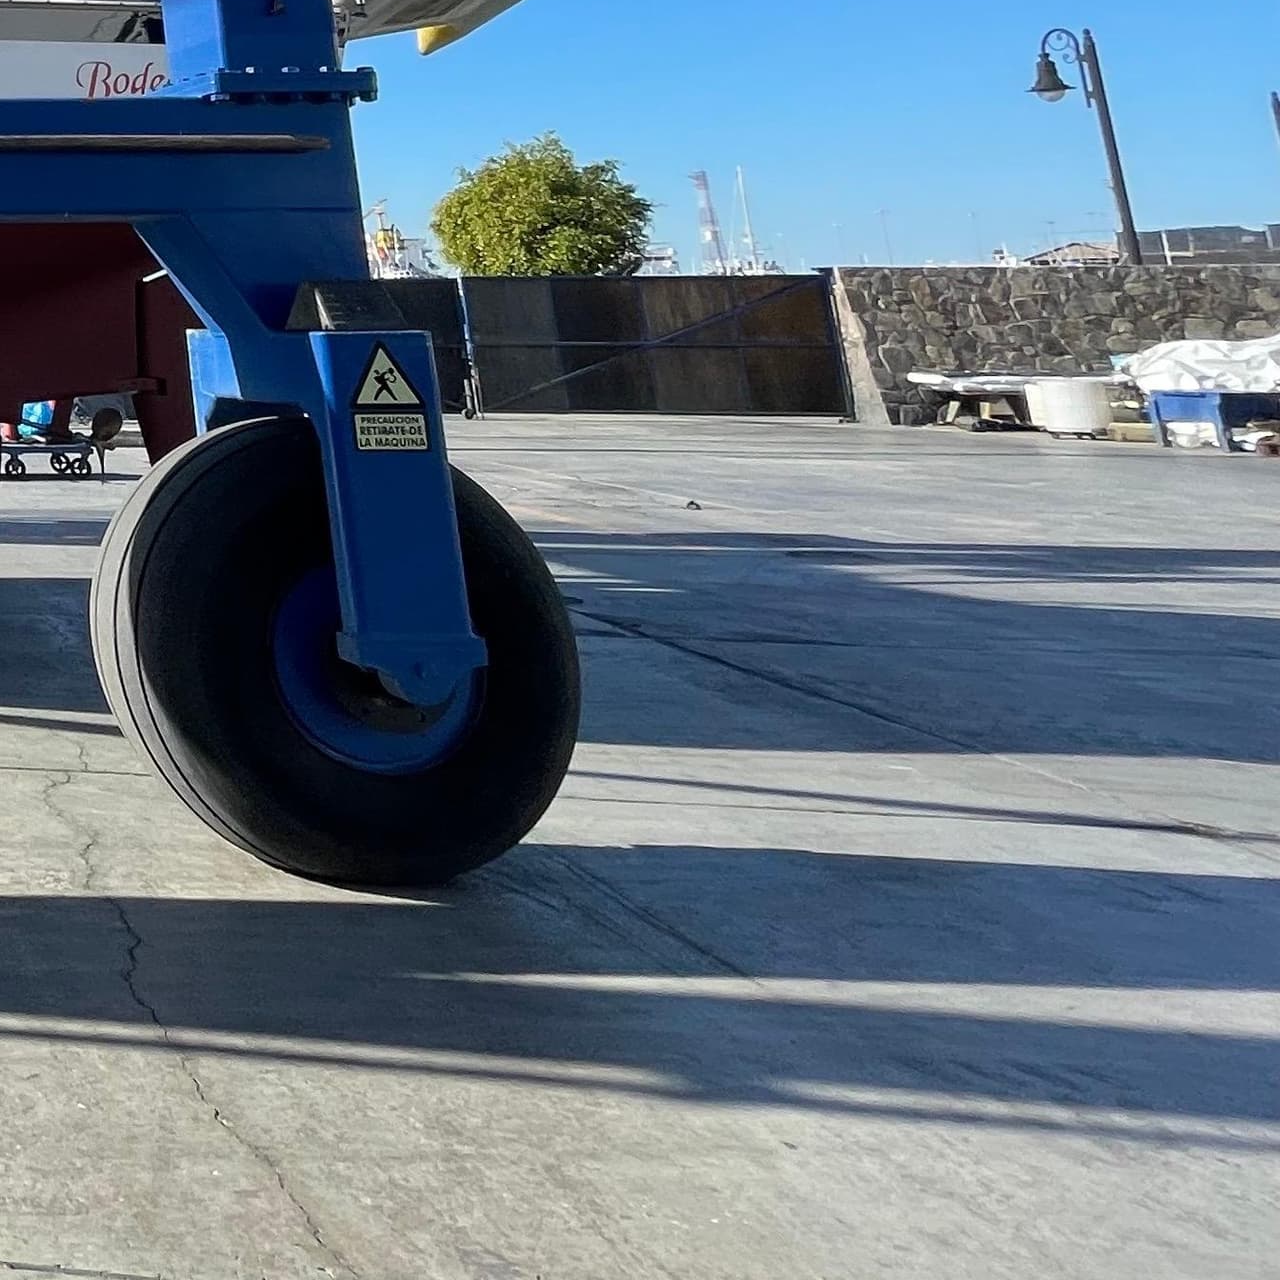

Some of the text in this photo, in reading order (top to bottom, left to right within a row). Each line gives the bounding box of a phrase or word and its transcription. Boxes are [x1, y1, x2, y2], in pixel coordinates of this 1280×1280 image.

[75, 61, 167, 100] Rode
[360, 416, 419, 424] PRECAUCION
[359, 426, 423, 435] RETIRATE DE
[359, 437, 426, 447] LA MAQUINA
